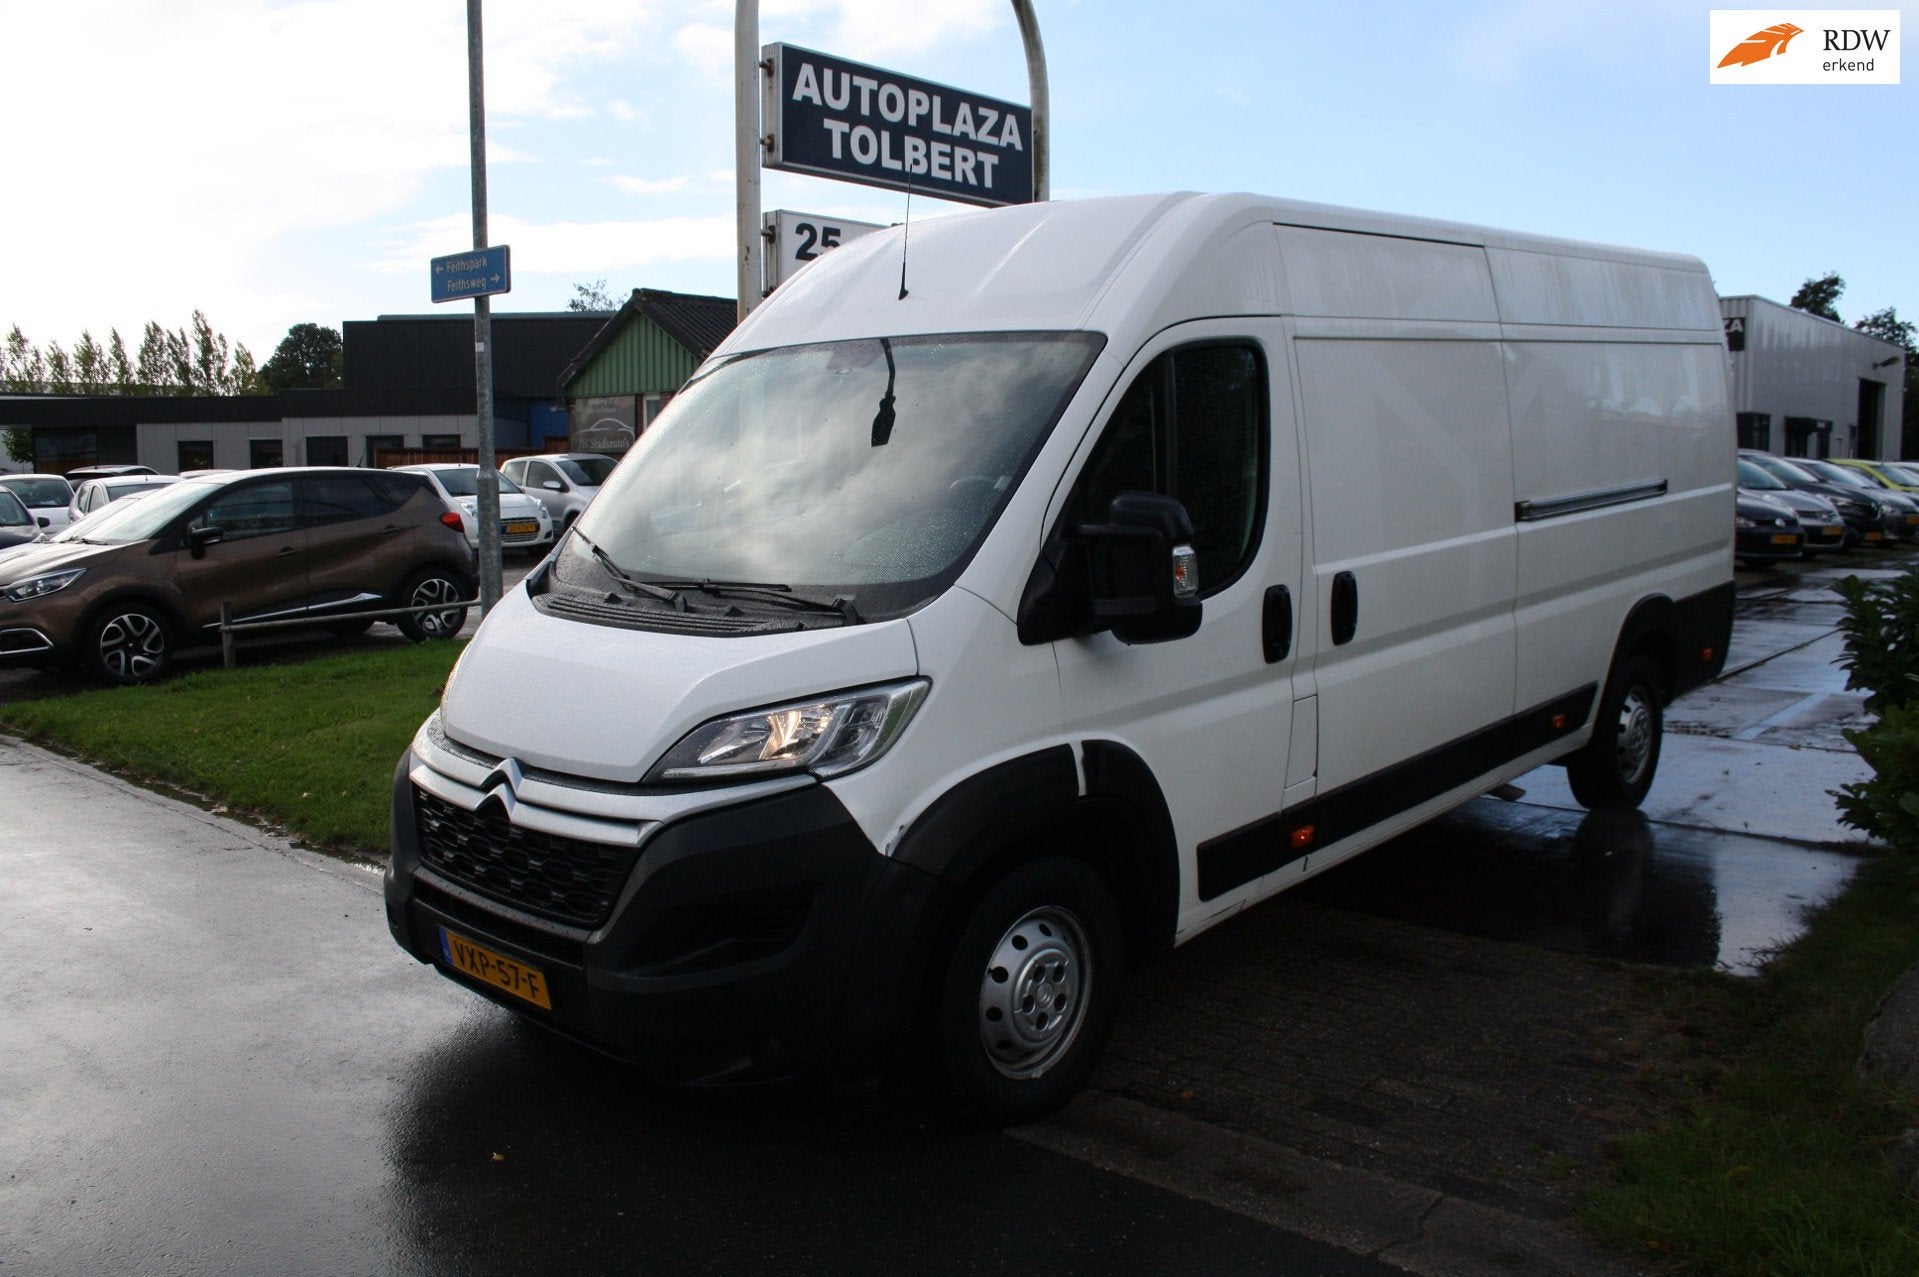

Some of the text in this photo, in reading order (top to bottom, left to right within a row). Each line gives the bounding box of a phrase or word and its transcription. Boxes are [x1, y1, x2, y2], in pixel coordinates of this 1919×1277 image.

[792, 62, 1023, 151] AUTOPLAZA
[823, 118, 999, 189] TOLBERT
[446, 256, 488, 274] Feithspark
[447, 277, 487, 293] Feithsweg
[453, 939, 539, 998] VXP-57-F
